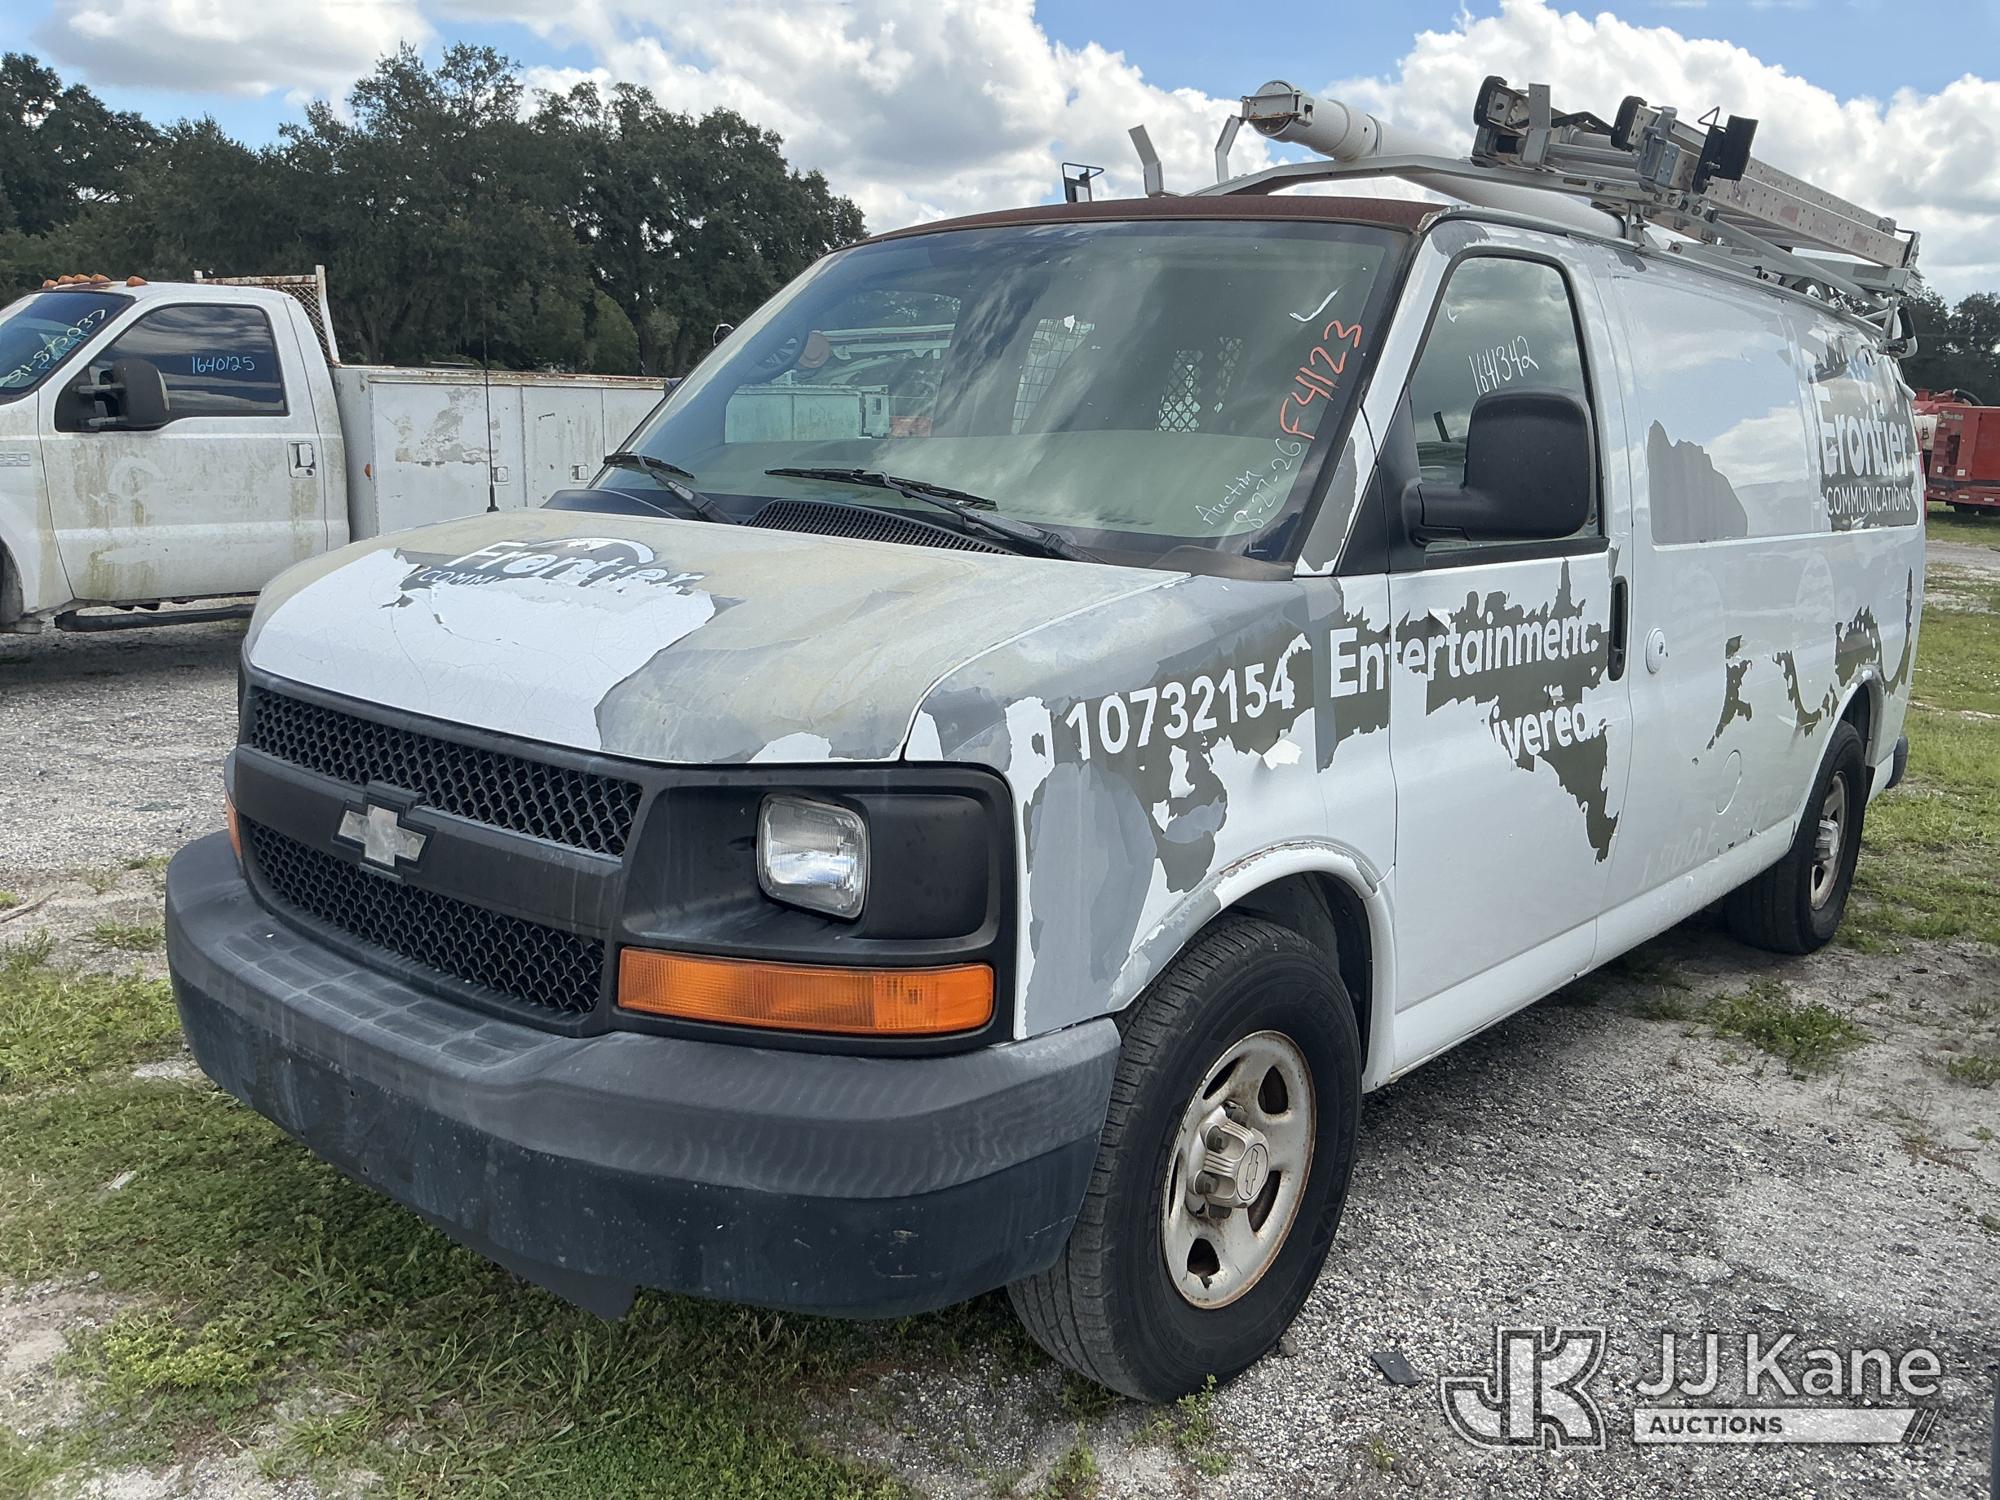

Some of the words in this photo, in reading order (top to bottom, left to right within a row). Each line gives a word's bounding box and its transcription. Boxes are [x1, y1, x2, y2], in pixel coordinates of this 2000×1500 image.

[191, 356, 256, 374] 1640125
[1279, 319, 1362, 440] F4123
[1813, 384, 1908, 477] Frontier
[1195, 470, 1263, 525] Auction
[1233, 438, 1302, 529] 8-27-26
[1826, 484, 1911, 516] COMMUNICATIONS
[444, 541, 705, 589] Frontier
[1064, 656, 1297, 760] 10732154
